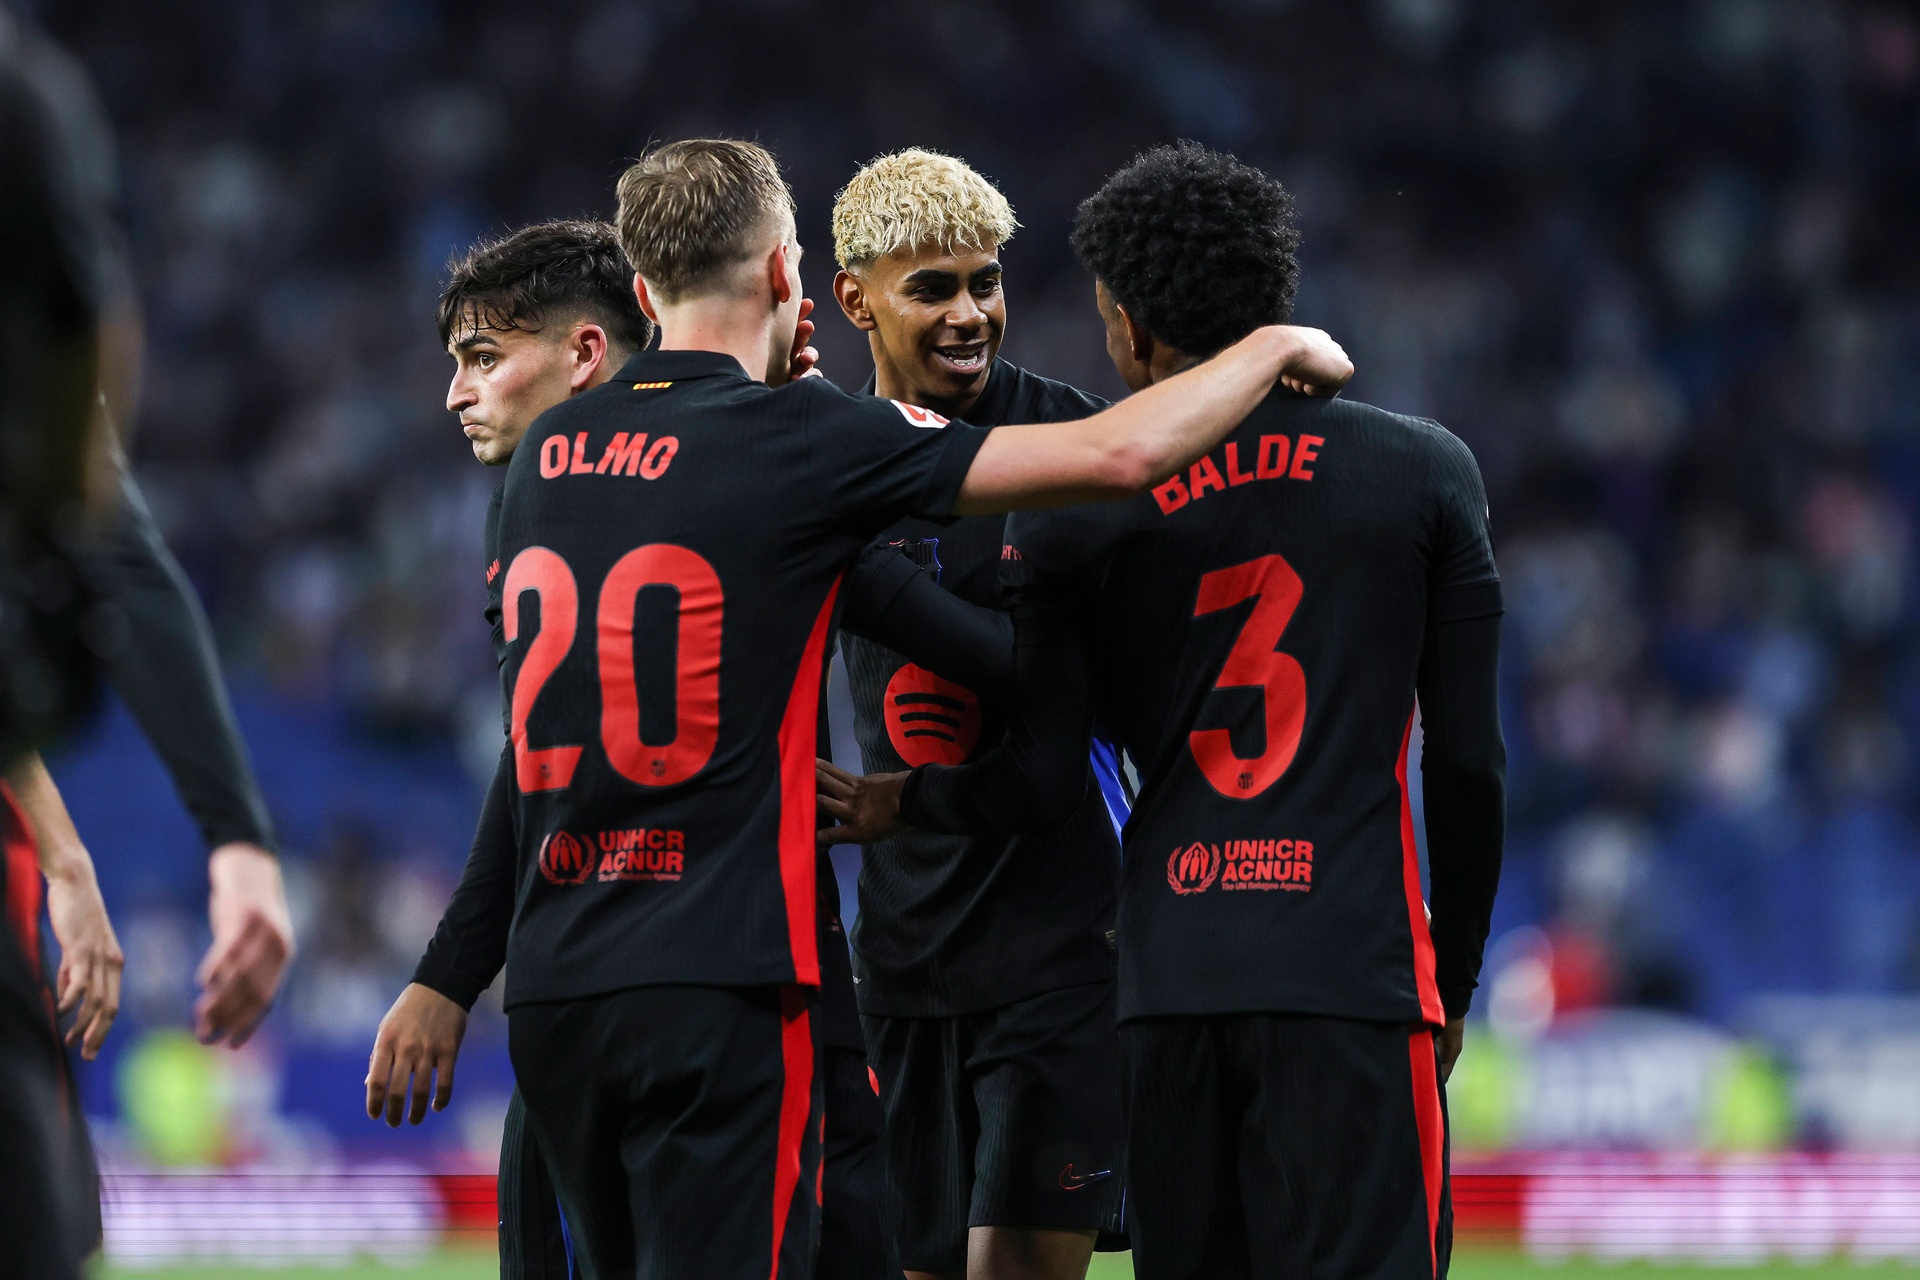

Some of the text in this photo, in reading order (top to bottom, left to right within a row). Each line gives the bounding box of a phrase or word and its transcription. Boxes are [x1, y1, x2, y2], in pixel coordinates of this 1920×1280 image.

[540, 431, 679, 480] OLMO
[1151, 433, 1325, 516] BALDE
[502, 543, 724, 795] 20
[1189, 554, 1307, 799] 3
[599, 828, 685, 852] UNHCR
[1224, 838, 1314, 861] UNHCR
[597, 850, 685, 873] ACNUR
[1221, 860, 1313, 882] ACNUR
